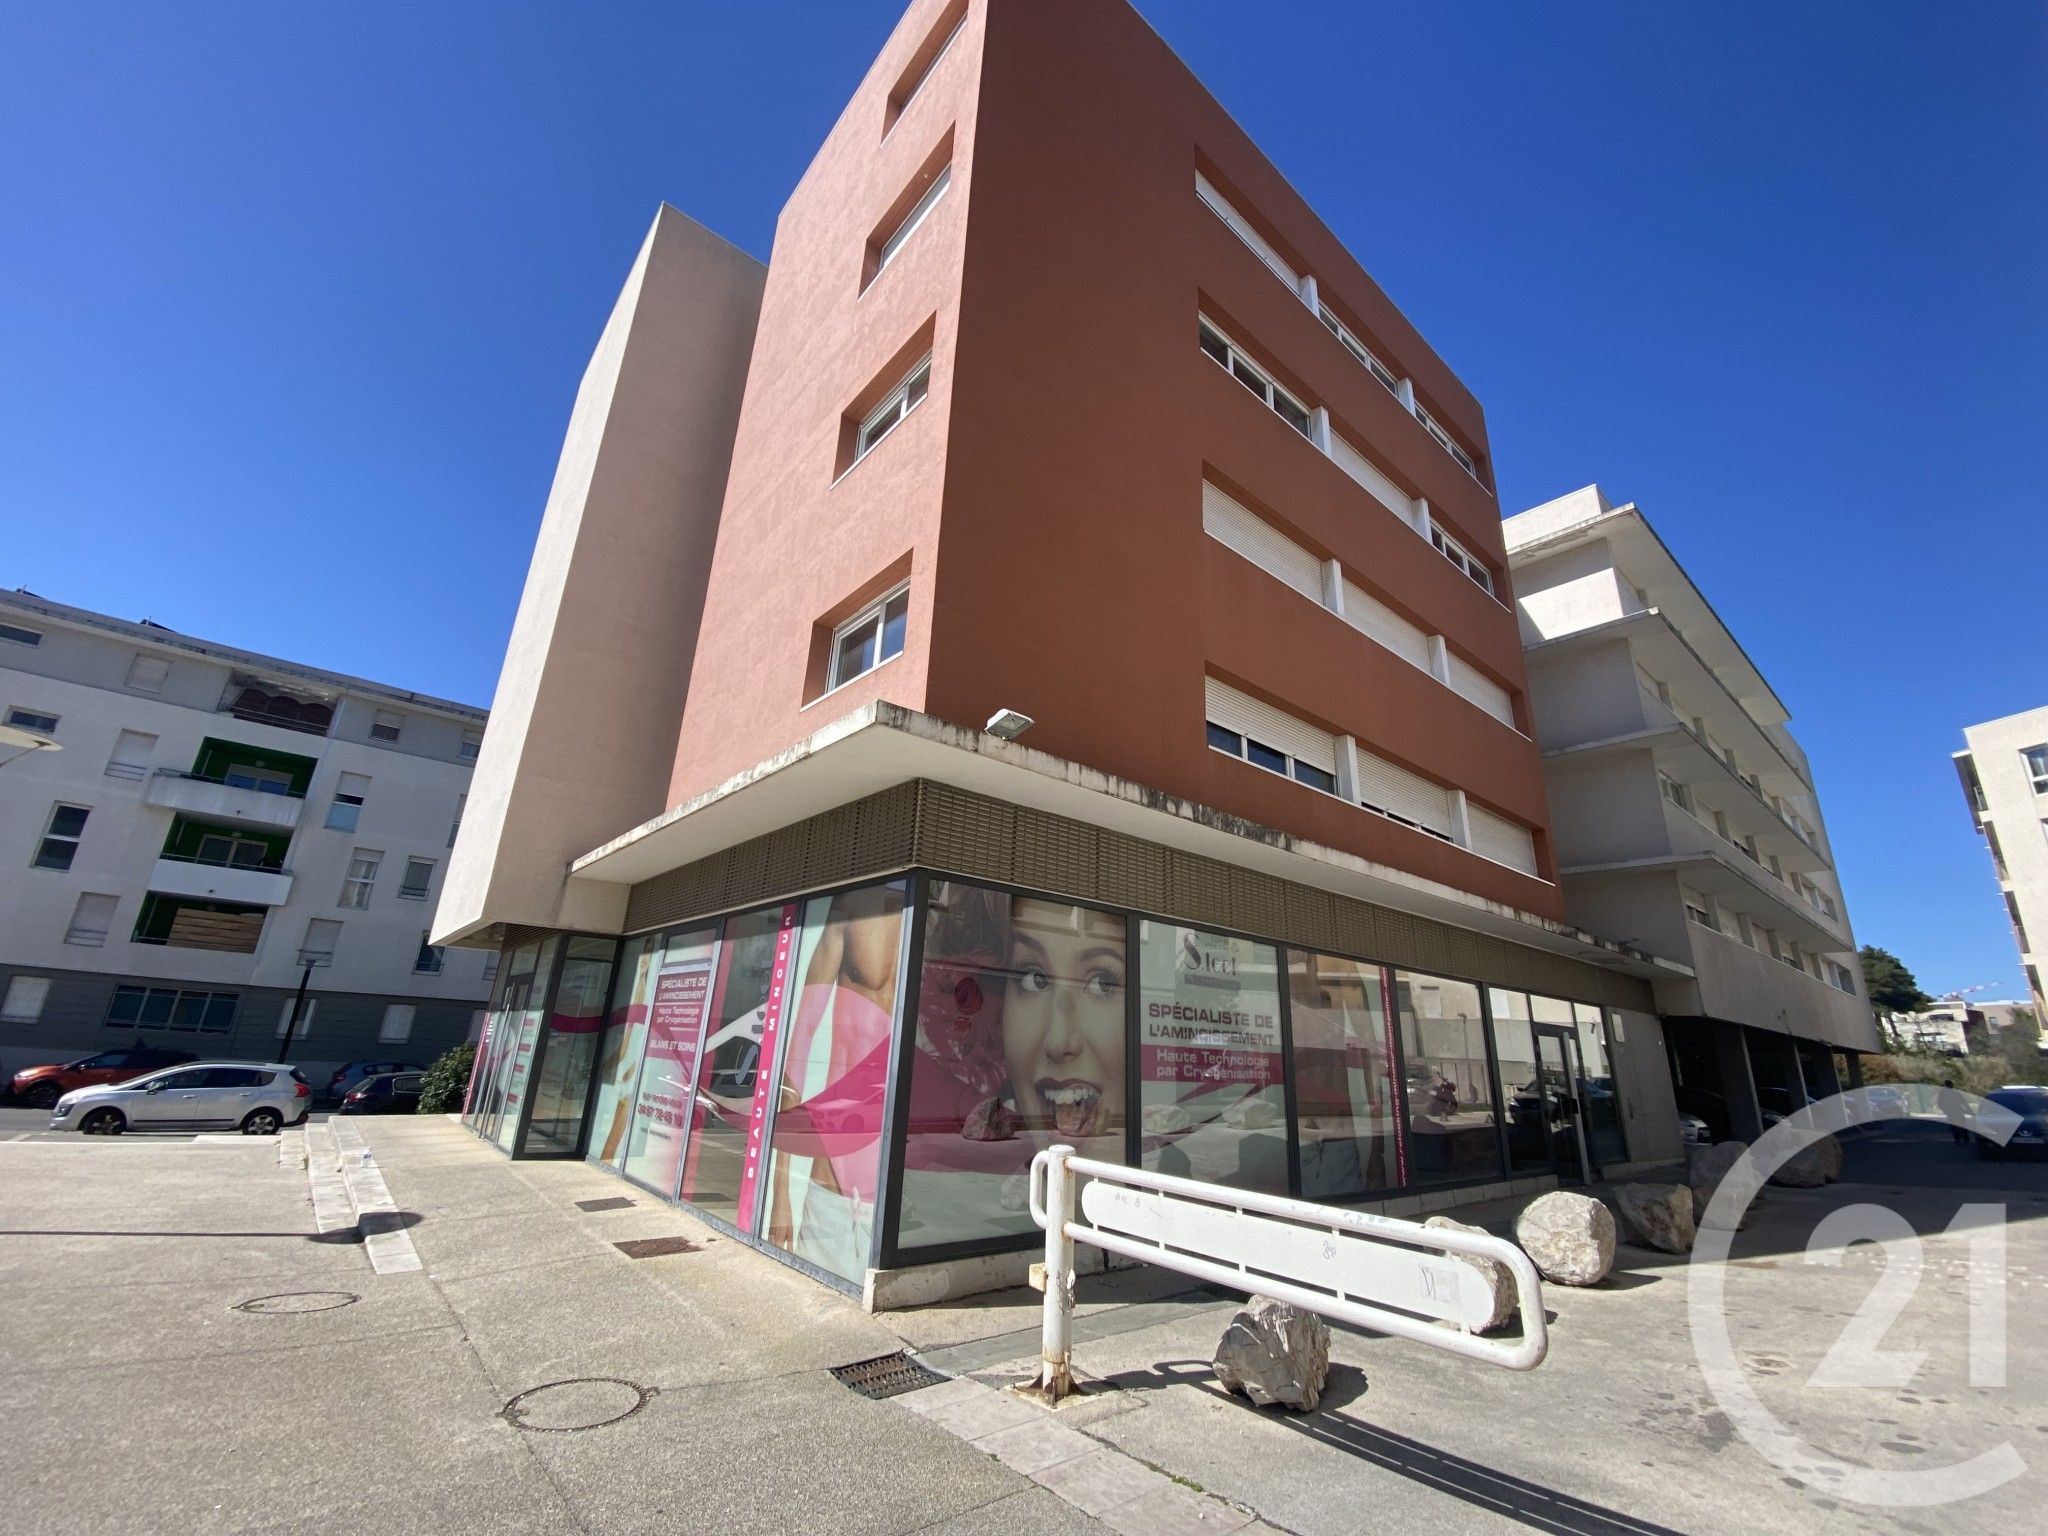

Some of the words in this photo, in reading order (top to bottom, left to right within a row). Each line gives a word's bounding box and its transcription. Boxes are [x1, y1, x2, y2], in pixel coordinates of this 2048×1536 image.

[769, 916, 792, 1031] MINCEUR
[1148, 1002, 1250, 1027] SPÉCIALISTE
[1254, 1014, 1274, 1029] DE
[1156, 1048, 1197, 1063] Haute
[1201, 1050, 1270, 1071] Technologie
[1156, 1066, 1179, 1079] par
